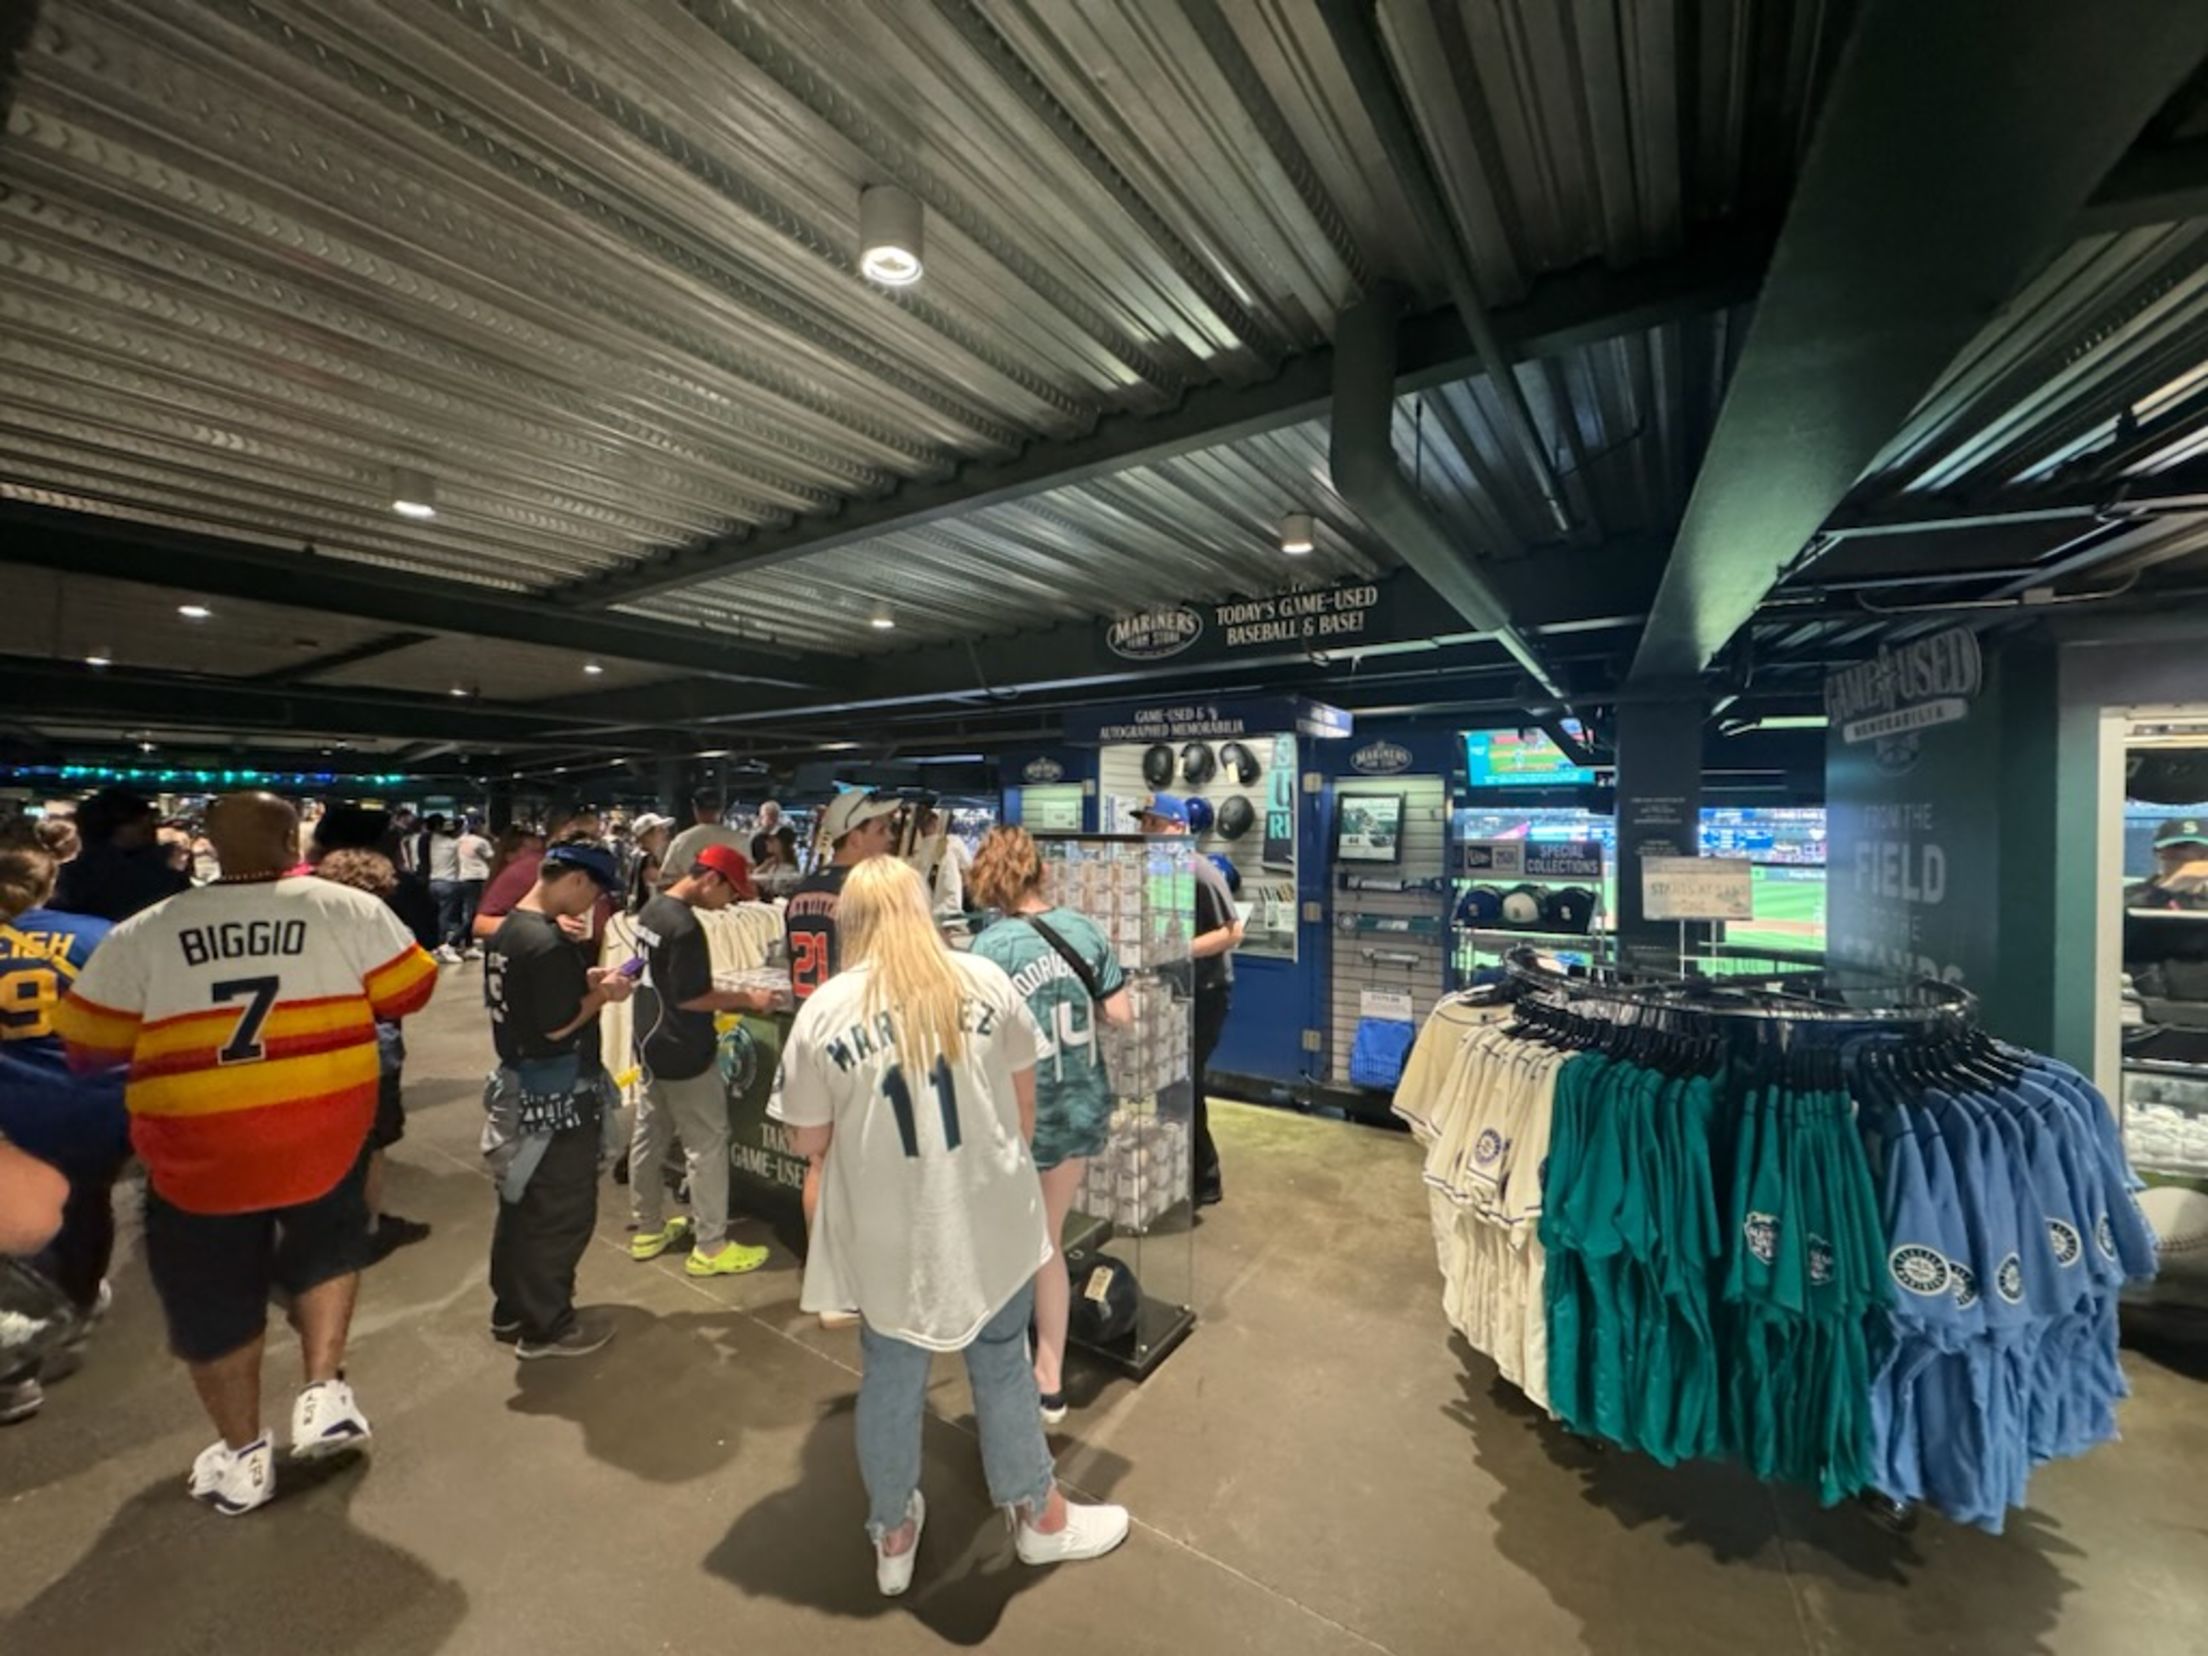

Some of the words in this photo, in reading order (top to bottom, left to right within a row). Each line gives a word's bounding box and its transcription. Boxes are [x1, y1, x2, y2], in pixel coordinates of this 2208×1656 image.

[1114, 611, 1197, 646] MARINERS
[1216, 600, 1276, 627] TODAY'S
[1279, 586, 1379, 618] GAME-USED
[1226, 621, 1298, 647] BASEBALL
[1303, 617, 1314, 637] &
[1526, 858, 1598, 874] COLLECTIONS
[1539, 844, 1585, 859] SPECIAL
[1854, 840, 1946, 904] FIELD
[178, 919, 307, 967] BIGGIO
[790, 930, 829, 997] 21
[211, 974, 281, 1067] 7
[826, 999, 996, 1073] MAREZ
[881, 1052, 963, 1158] 11
